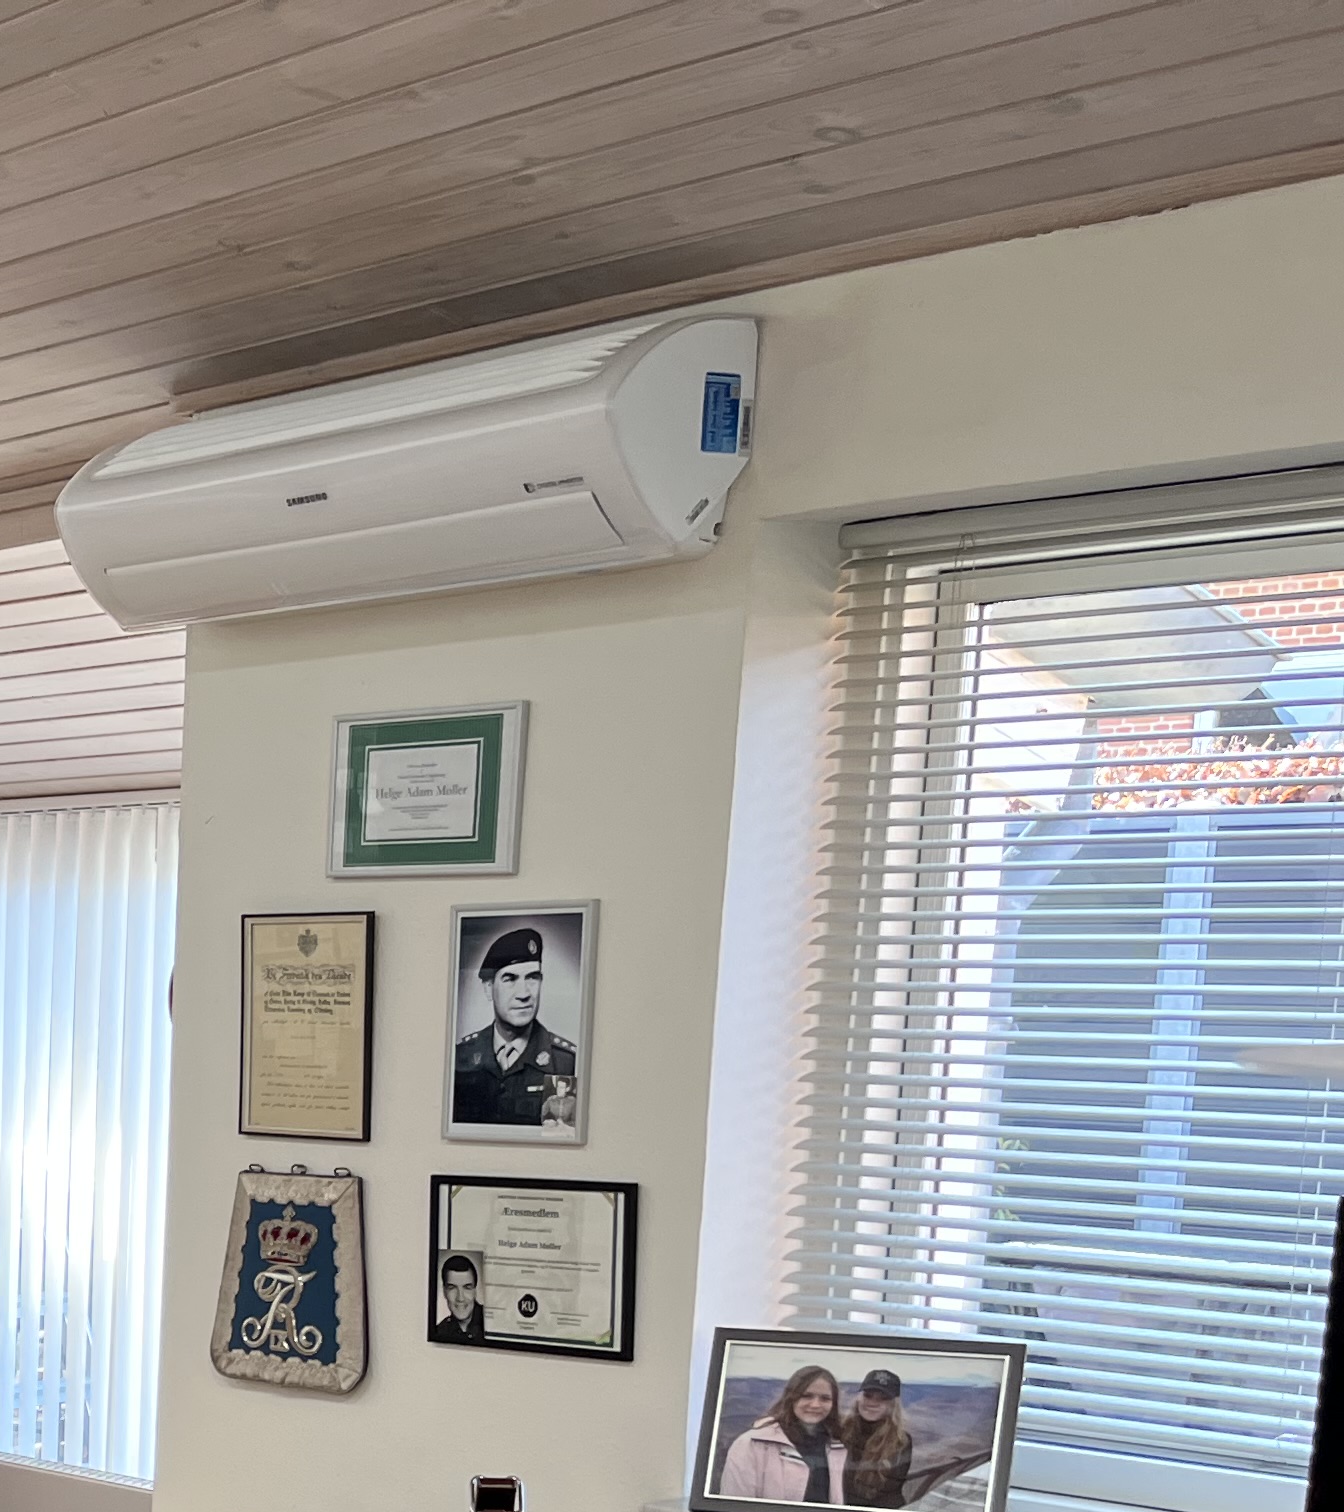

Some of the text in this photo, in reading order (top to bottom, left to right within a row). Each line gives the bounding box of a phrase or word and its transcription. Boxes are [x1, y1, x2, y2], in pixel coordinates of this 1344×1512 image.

[375, 787, 403, 800] Helge
[405, 786, 433, 798] Adam
[500, 1206, 560, 1219] Æresmedlem
